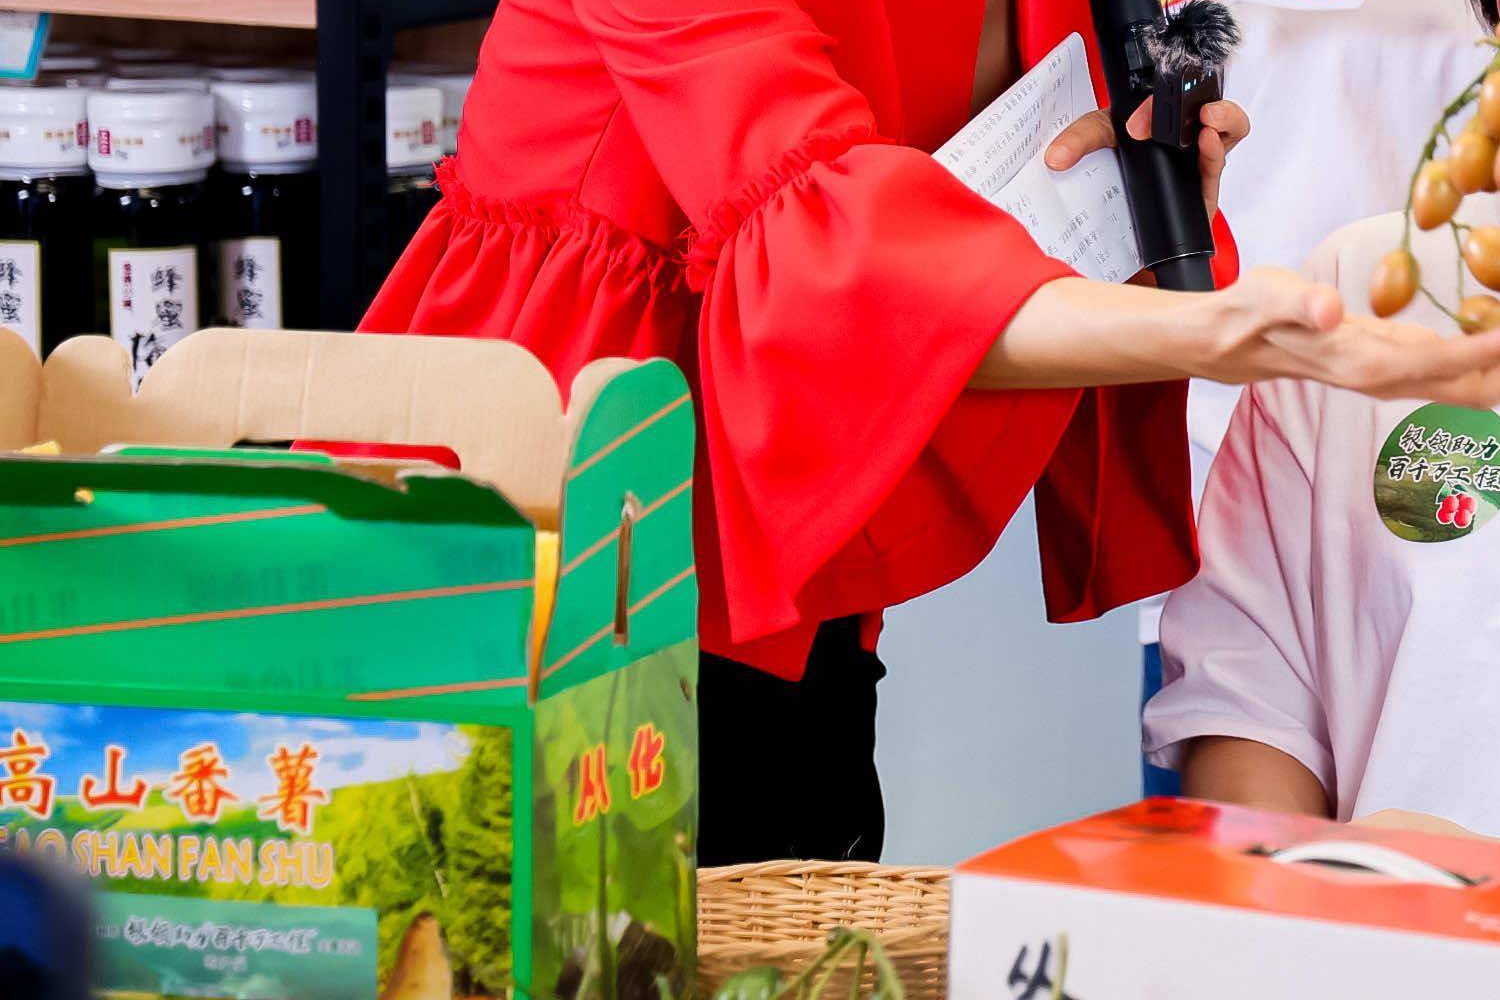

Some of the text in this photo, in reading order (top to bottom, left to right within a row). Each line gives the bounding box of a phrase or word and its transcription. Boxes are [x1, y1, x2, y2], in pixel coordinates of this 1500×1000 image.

[0, 730, 330, 834] 高山番薯
[574, 722, 666, 827] 从化
[72, 829, 173, 880] SHAN
[179, 835, 253, 885] FAN
[258, 838, 335, 889] SHU
